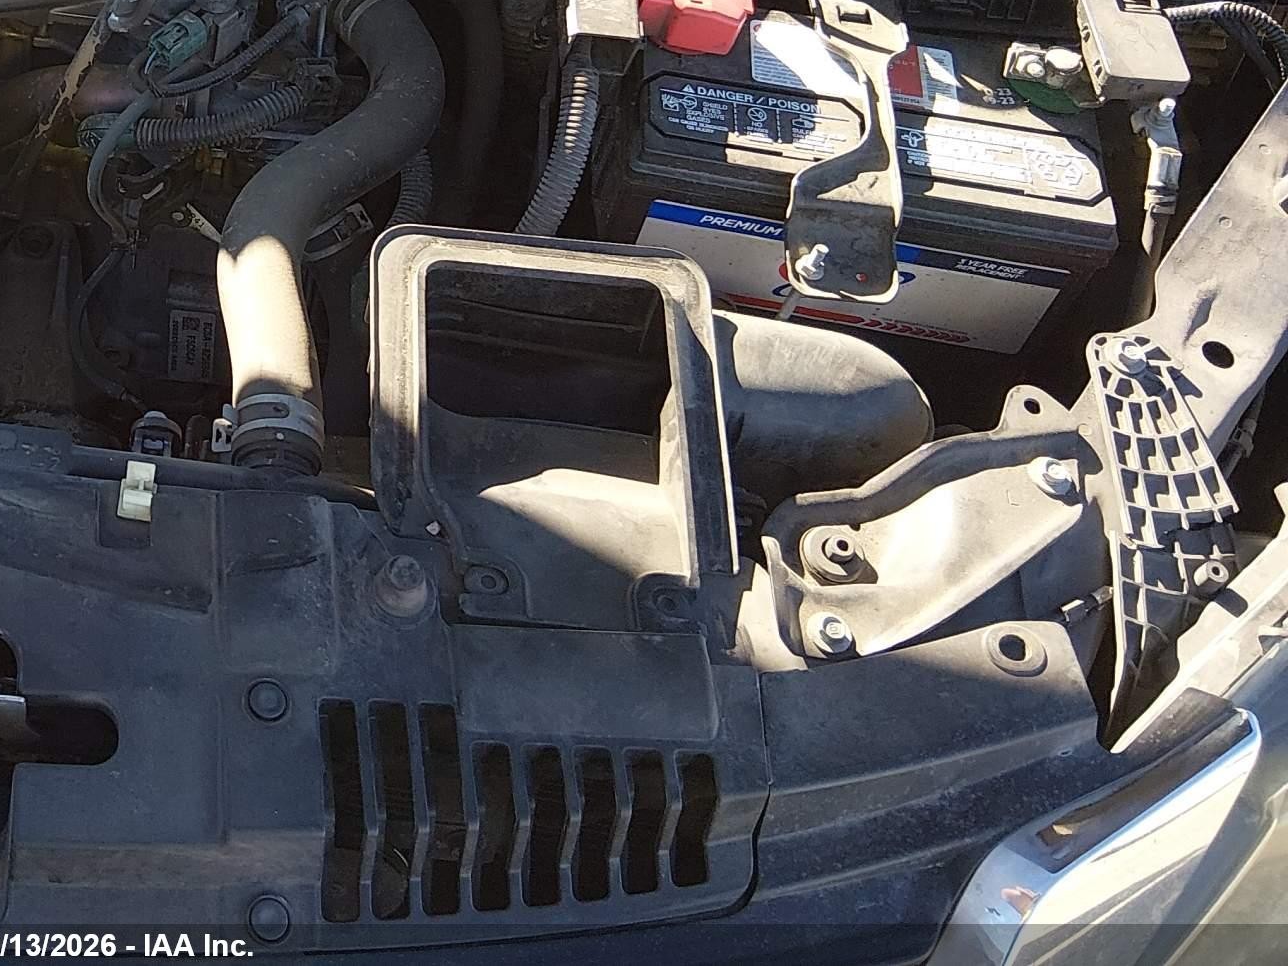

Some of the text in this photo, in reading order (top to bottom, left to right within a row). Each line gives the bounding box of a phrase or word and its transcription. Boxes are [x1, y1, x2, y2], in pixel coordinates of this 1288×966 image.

[697, 86, 753, 103] DANGER
[768, 97, 820, 113] POISON
[700, 215, 784, 236] PREMIUM
[968, 260, 997, 271] YEAR
